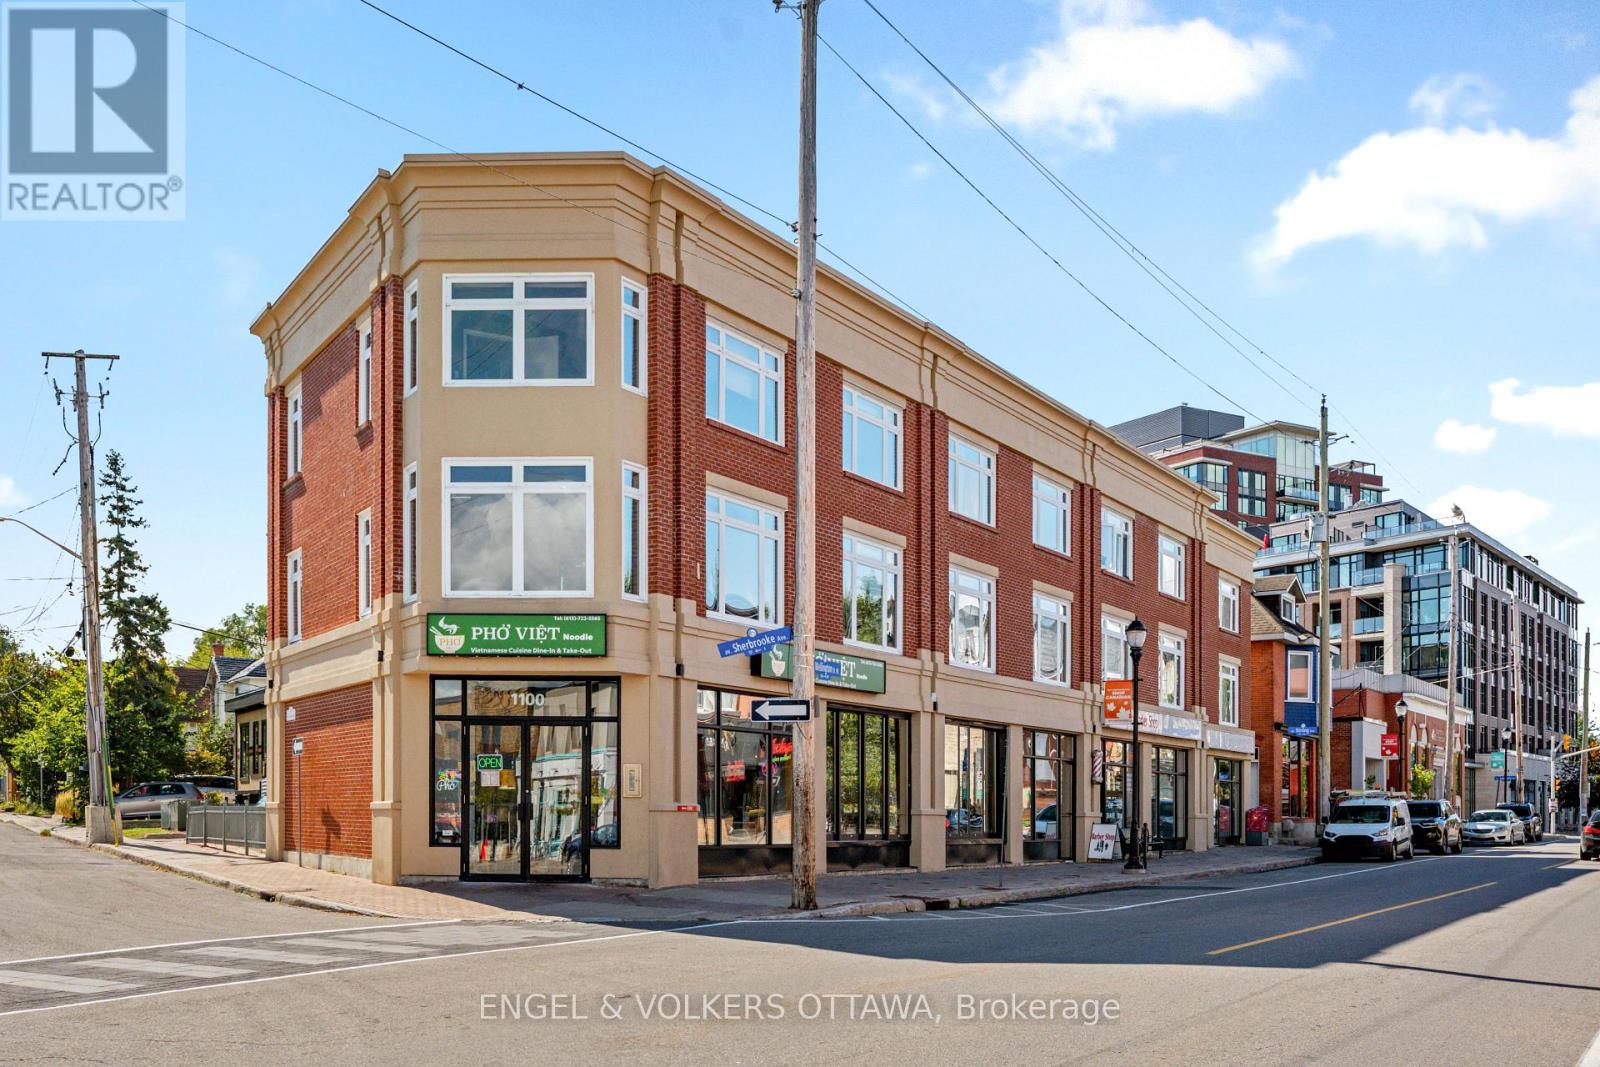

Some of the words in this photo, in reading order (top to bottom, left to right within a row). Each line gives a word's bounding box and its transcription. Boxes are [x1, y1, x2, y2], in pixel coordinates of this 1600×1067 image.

[563, 633, 593, 641] Noodle
[732, 634, 776, 653] Sherbrooke
[511, 693, 545, 706] 1100
[479, 758, 502, 768] OPEN
